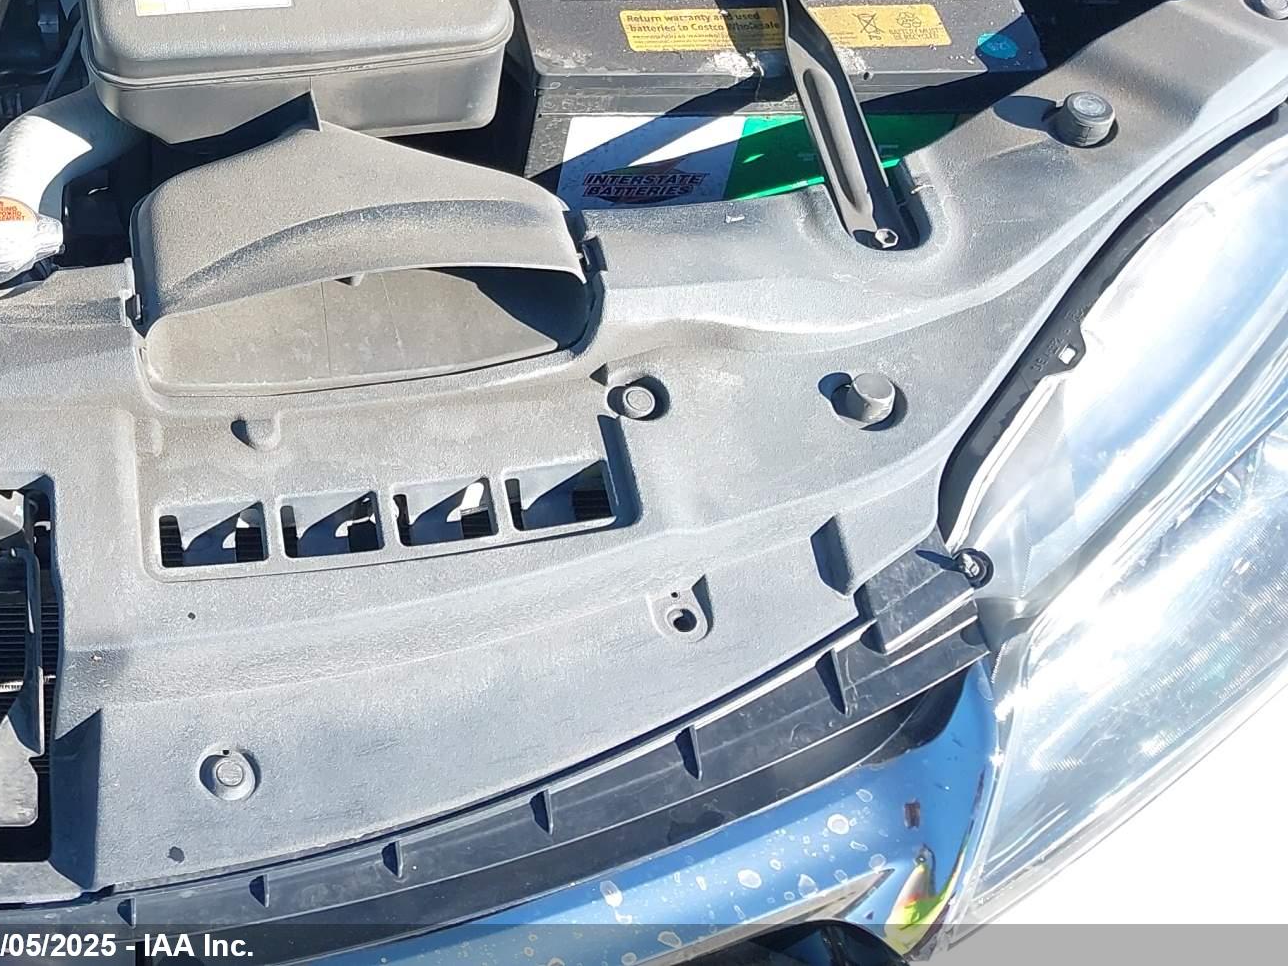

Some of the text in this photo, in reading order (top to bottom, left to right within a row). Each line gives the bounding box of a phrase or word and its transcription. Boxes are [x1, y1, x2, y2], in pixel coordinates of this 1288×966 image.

[627, 14, 662, 23] Return
[713, 12, 732, 22] and
[735, 12, 760, 21] used
[629, 22, 676, 32] batteries
[678, 23, 689, 32] to
[691, 22, 724, 32] Costco
[585, 173, 704, 185] INTERSTATE
[585, 185, 693, 196] BATTERIES
